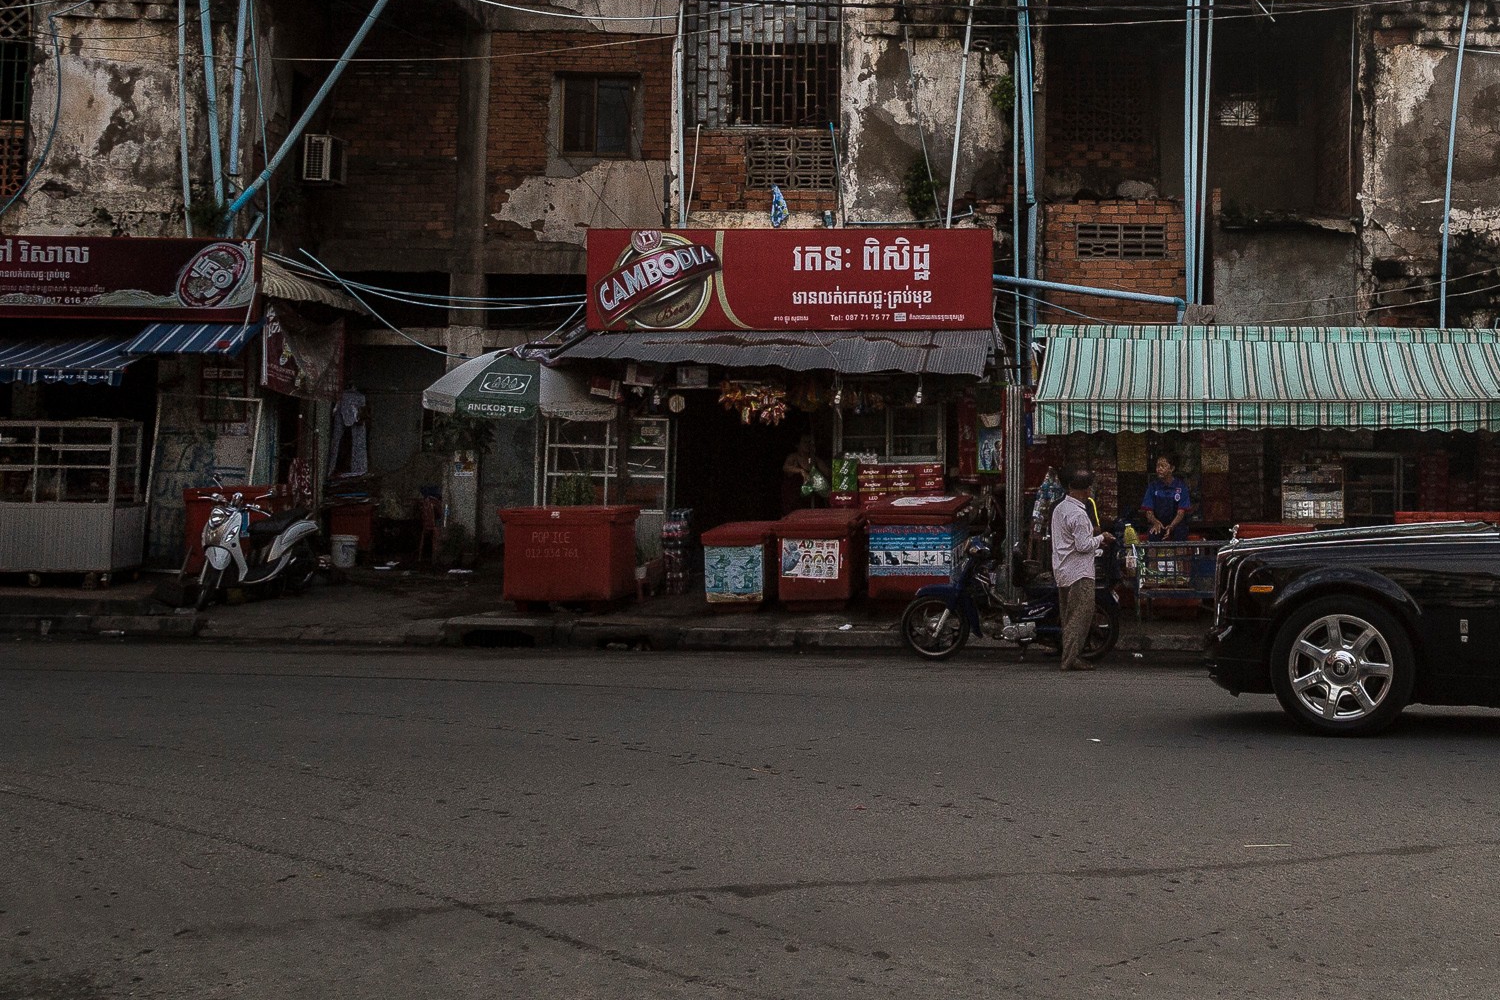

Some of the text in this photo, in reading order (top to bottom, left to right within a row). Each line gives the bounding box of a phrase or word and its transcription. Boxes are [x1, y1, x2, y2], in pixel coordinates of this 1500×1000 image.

[191, 255, 234, 290] LEO
[600, 245, 716, 310] CAMBODIA
[64, 296, 80, 304] 616
[656, 301, 691, 323] Beer
[467, 403, 526, 414] ANGKOR TEP
[532, 531, 570, 543] POP ICE
